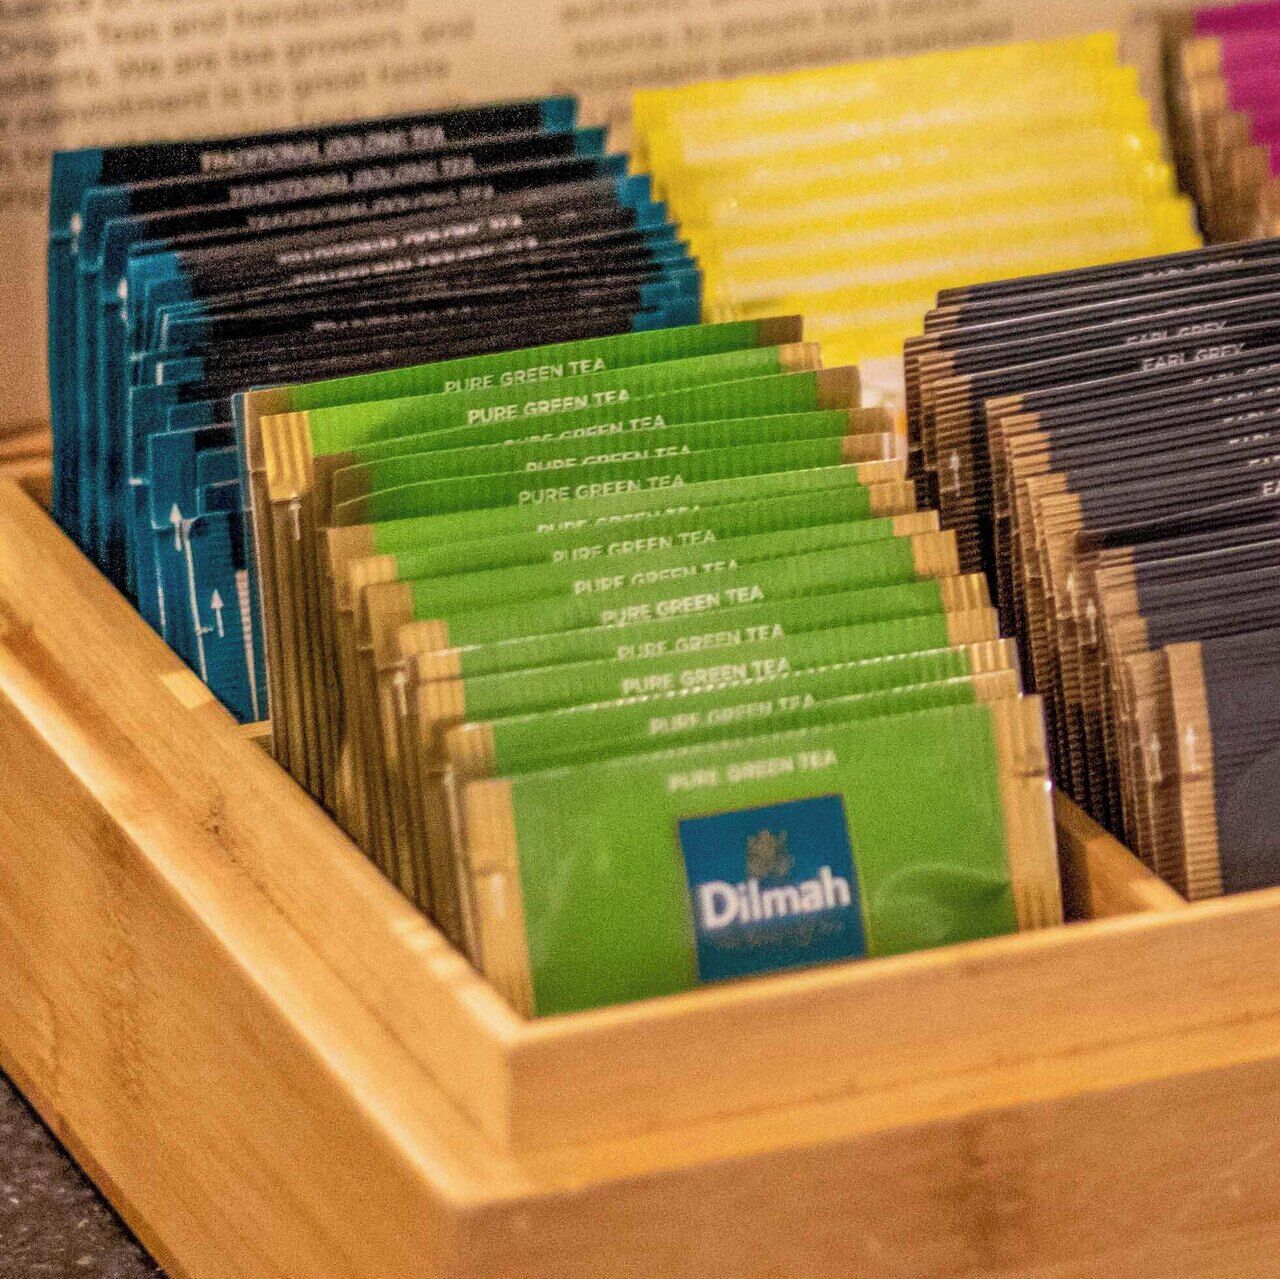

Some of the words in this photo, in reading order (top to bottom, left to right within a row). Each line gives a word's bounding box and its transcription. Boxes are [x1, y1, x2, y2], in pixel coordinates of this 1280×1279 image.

[1141, 352, 1187, 372] EARL
[1195, 342, 1247, 362] GREY
[444, 375, 493, 395] PURE
[500, 365, 562, 387] GREEN
[569, 358, 606, 376] TEA
[467, 404, 518, 426] PURE
[524, 395, 588, 416] GREEN
[593, 389, 630, 406] TEA
[518, 486, 570, 507] PURE
[575, 478, 641, 500] GREEN
[646, 474, 684, 491] TEA
[608, 536, 672, 556] GREEN
[679, 529, 716, 545] TEA
[601, 603, 651, 625] PURE
[656, 592, 720, 616] GREEN
[726, 585, 764, 604] TEA
[617, 640, 667, 660] PURE
[676, 629, 740, 652] GREEN
[747, 623, 784, 641] TEA
[622, 673, 673, 694] PURE
[680, 663, 746, 686] GREEN
[752, 657, 790, 677] TEA
[708, 701, 772, 724] GREEN
[667, 769, 718, 791] PURE
[727, 757, 793, 783] GREEN
[798, 749, 838, 771] TEA
[699, 865, 851, 931] Dilmah
